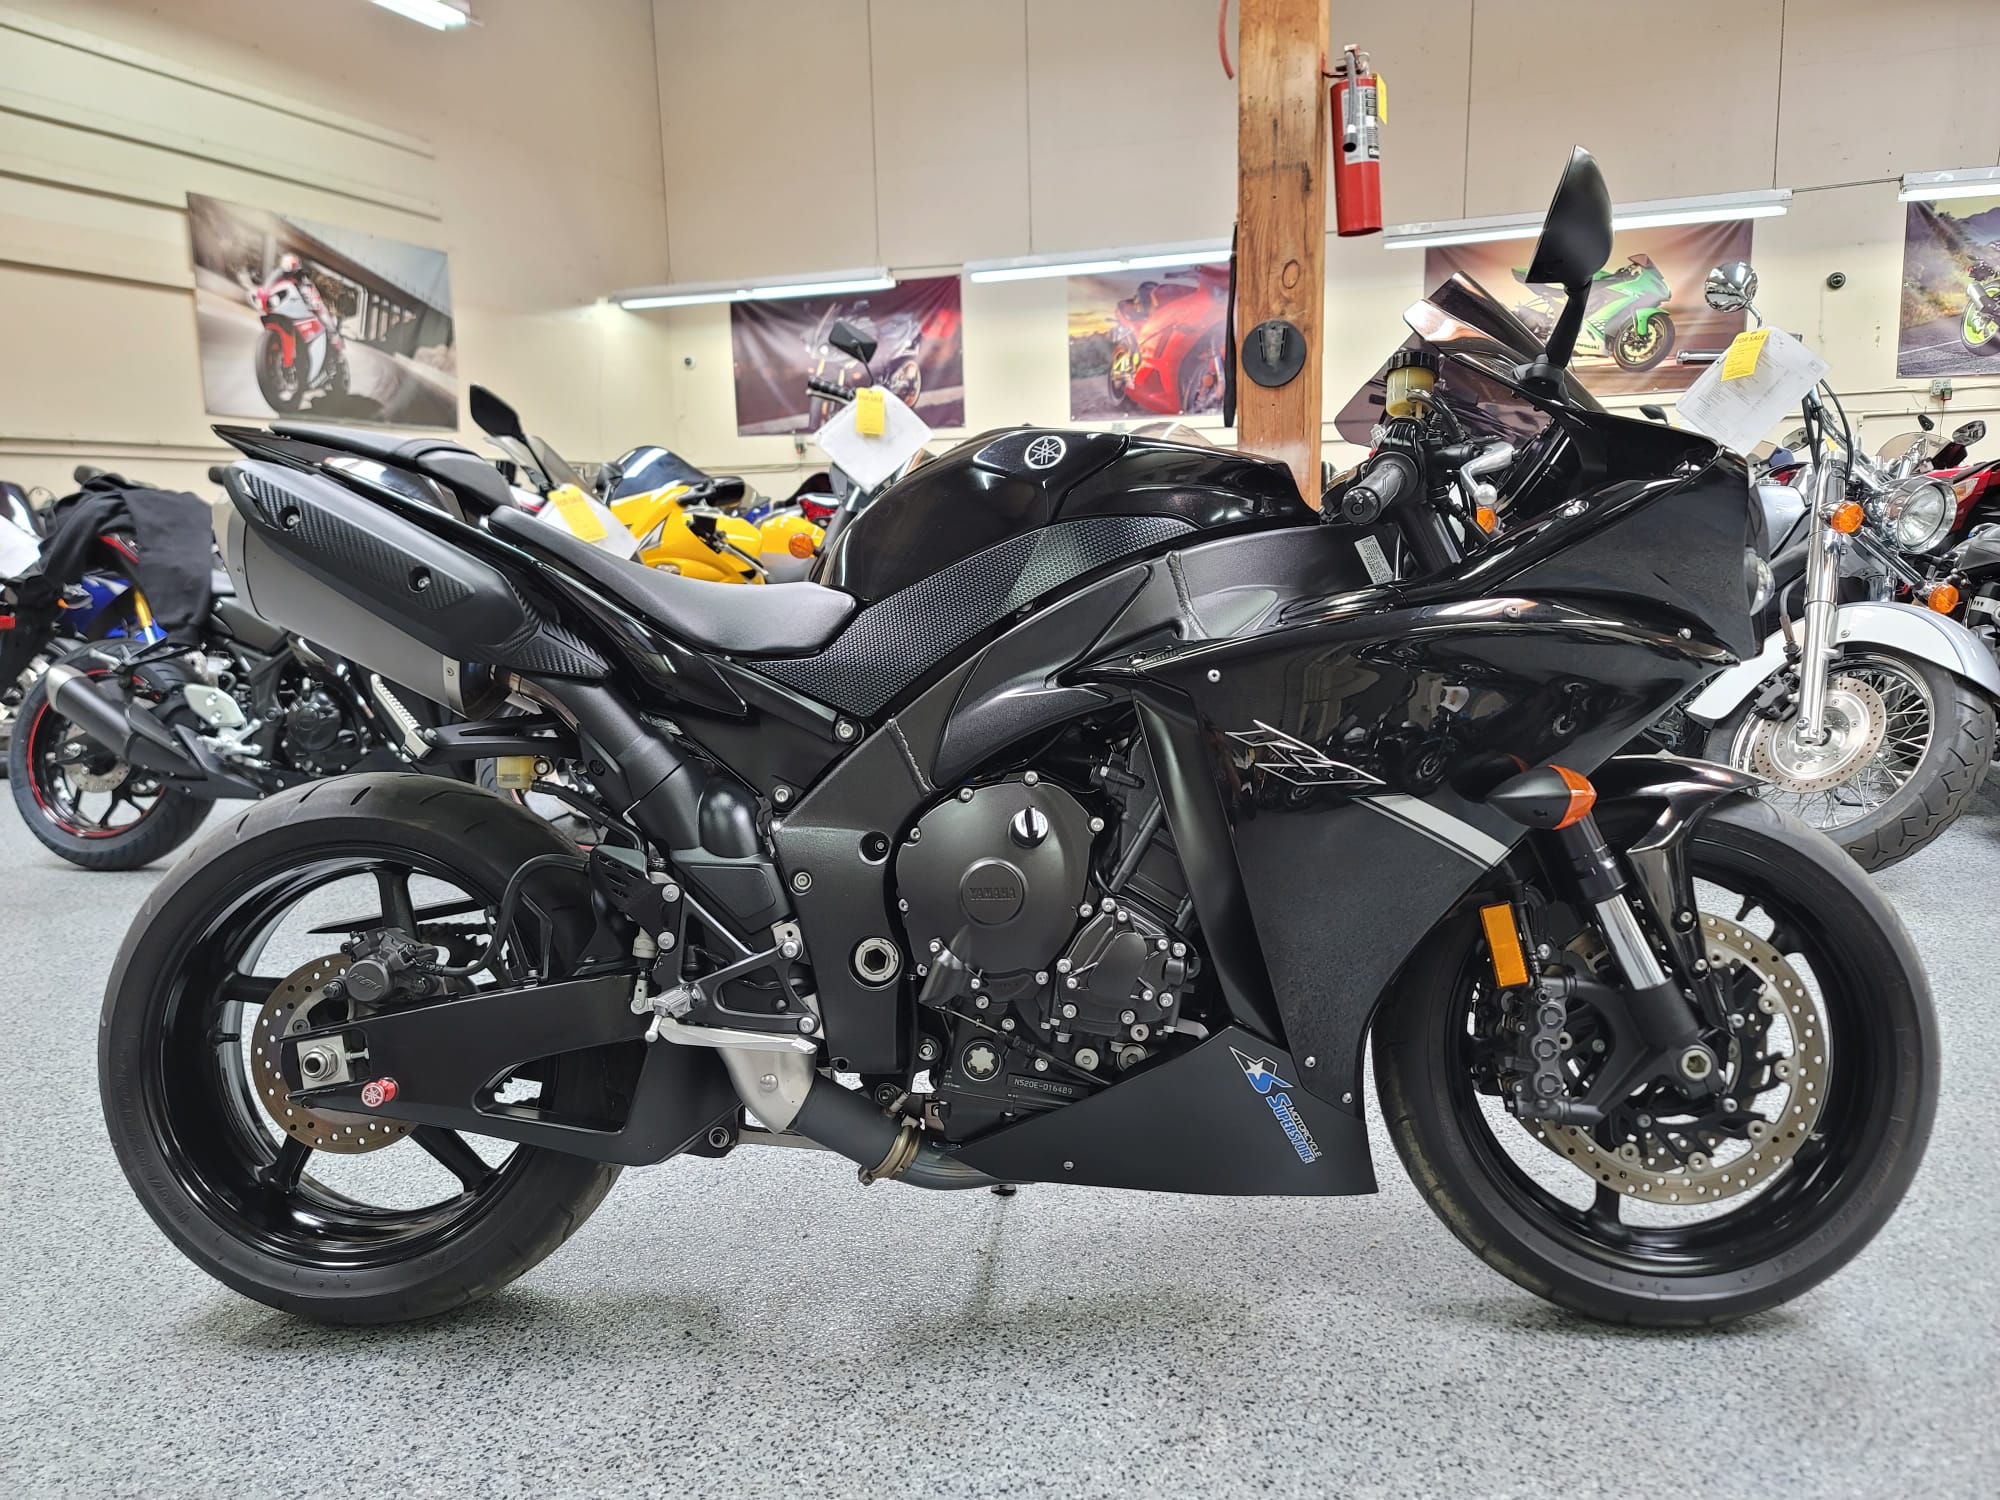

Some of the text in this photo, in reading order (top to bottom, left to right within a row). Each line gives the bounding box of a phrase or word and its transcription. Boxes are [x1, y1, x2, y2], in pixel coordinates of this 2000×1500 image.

[1749, 333, 1767, 342] SALE
[968, 887, 1017, 900] YAMAHA
[1265, 1092, 1316, 1165] SUPERSTORE
[1287, 1106, 1323, 1158] MOTORCYCLE
